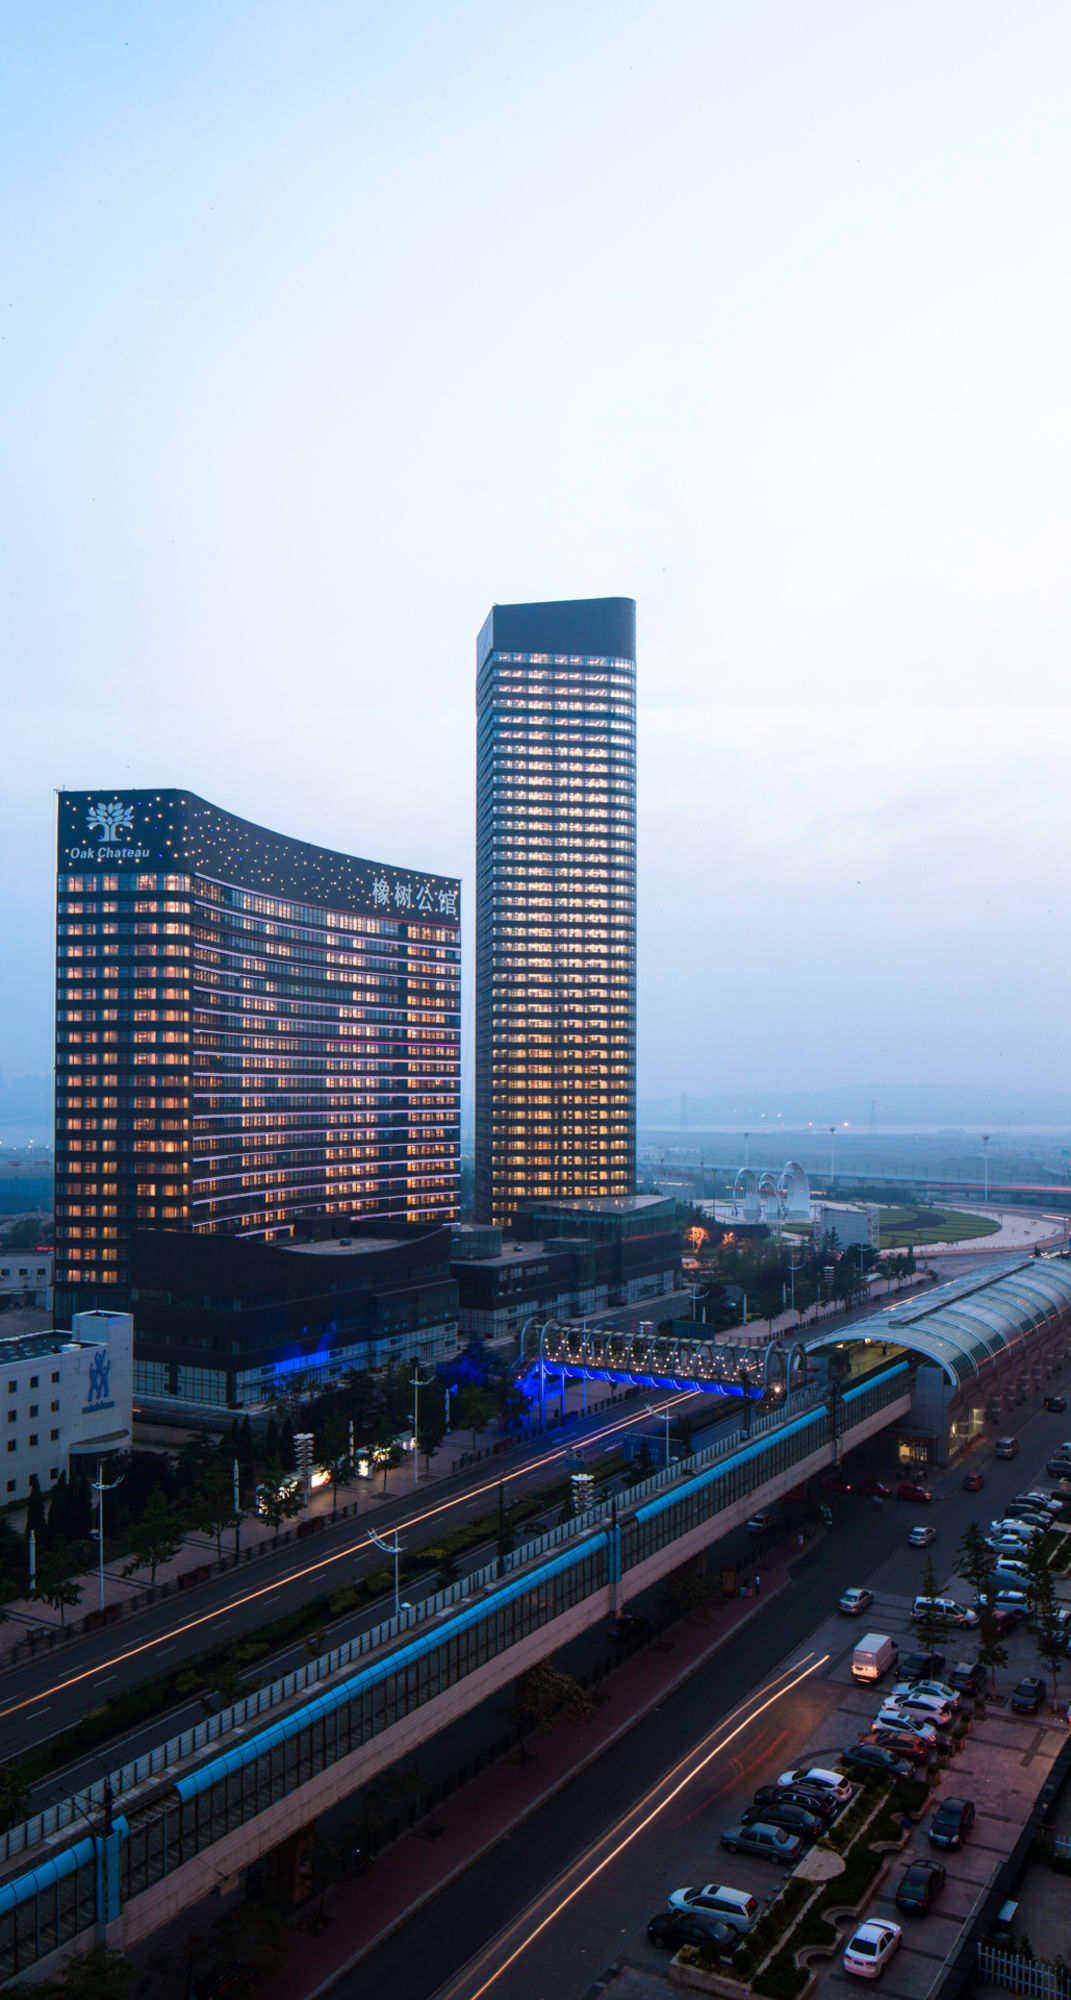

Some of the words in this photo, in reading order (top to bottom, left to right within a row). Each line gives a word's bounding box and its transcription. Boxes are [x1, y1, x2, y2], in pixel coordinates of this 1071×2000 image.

[70, 847, 95, 859] Oak
[97, 846, 150, 858] Chateau
[372, 877, 457, 916] 橡树公馆
